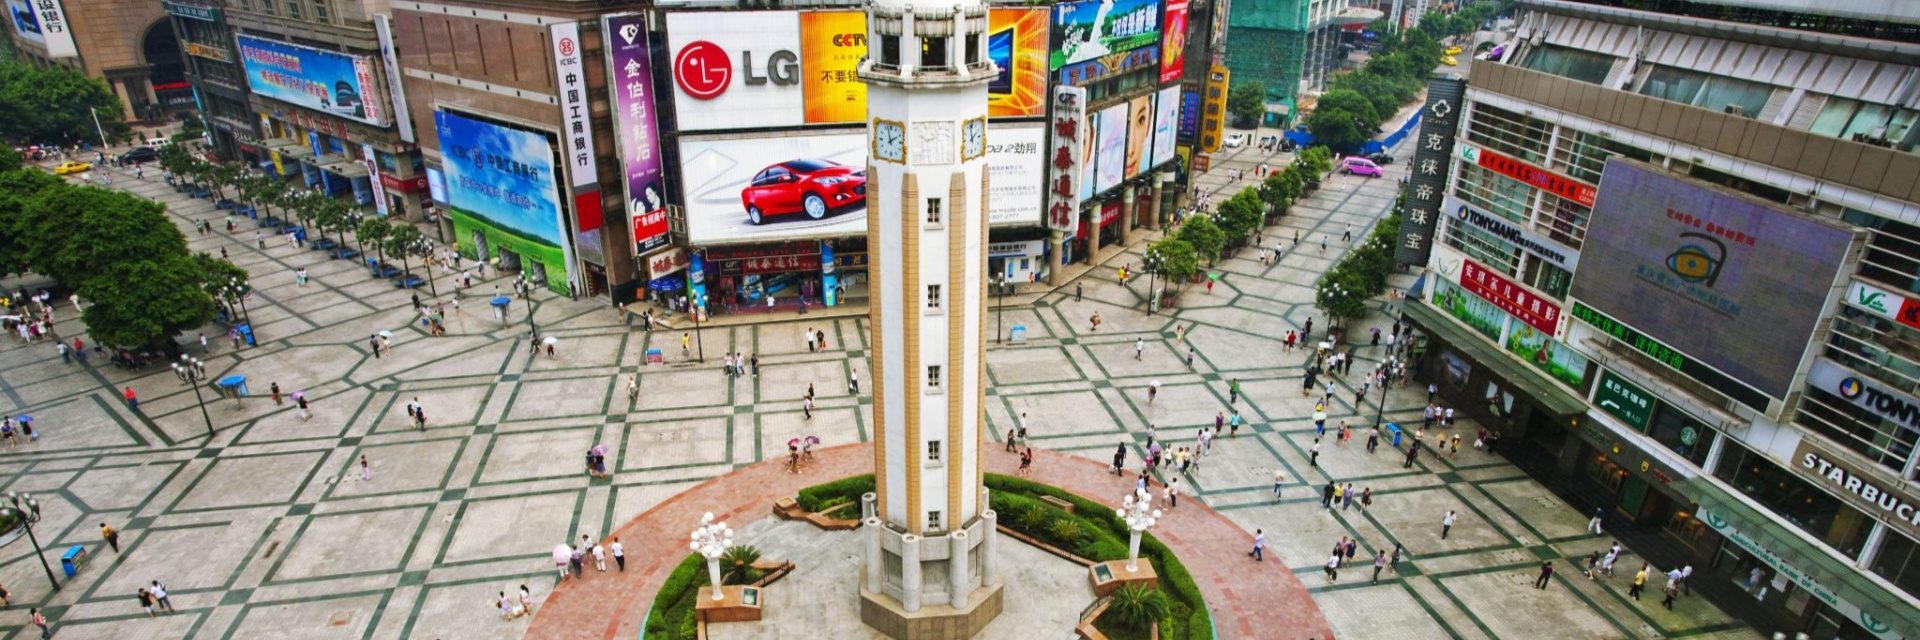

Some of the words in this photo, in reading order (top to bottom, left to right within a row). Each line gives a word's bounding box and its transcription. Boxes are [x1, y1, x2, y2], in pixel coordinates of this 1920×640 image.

[560, 57, 578, 66] ICBC
[742, 49, 800, 87] LG
[565, 72, 588, 167] 中国工商银行
[624, 58, 651, 162] 金伯利钻石
[487, 154, 538, 181] 中国工商银行
[1050, 117, 1077, 227] 诚泰通信
[1405, 132, 1444, 249] 克徕帝珠宝
[745, 255, 800, 270] 诚泰通信
[1605, 378, 1648, 409] 星巴克咖啡
[1730, 533, 1778, 567] AGRICULTURAL
[1779, 563, 1799, 581] BANK
[1801, 578, 1812, 589] OF
[1814, 587, 1838, 607] CHINA
